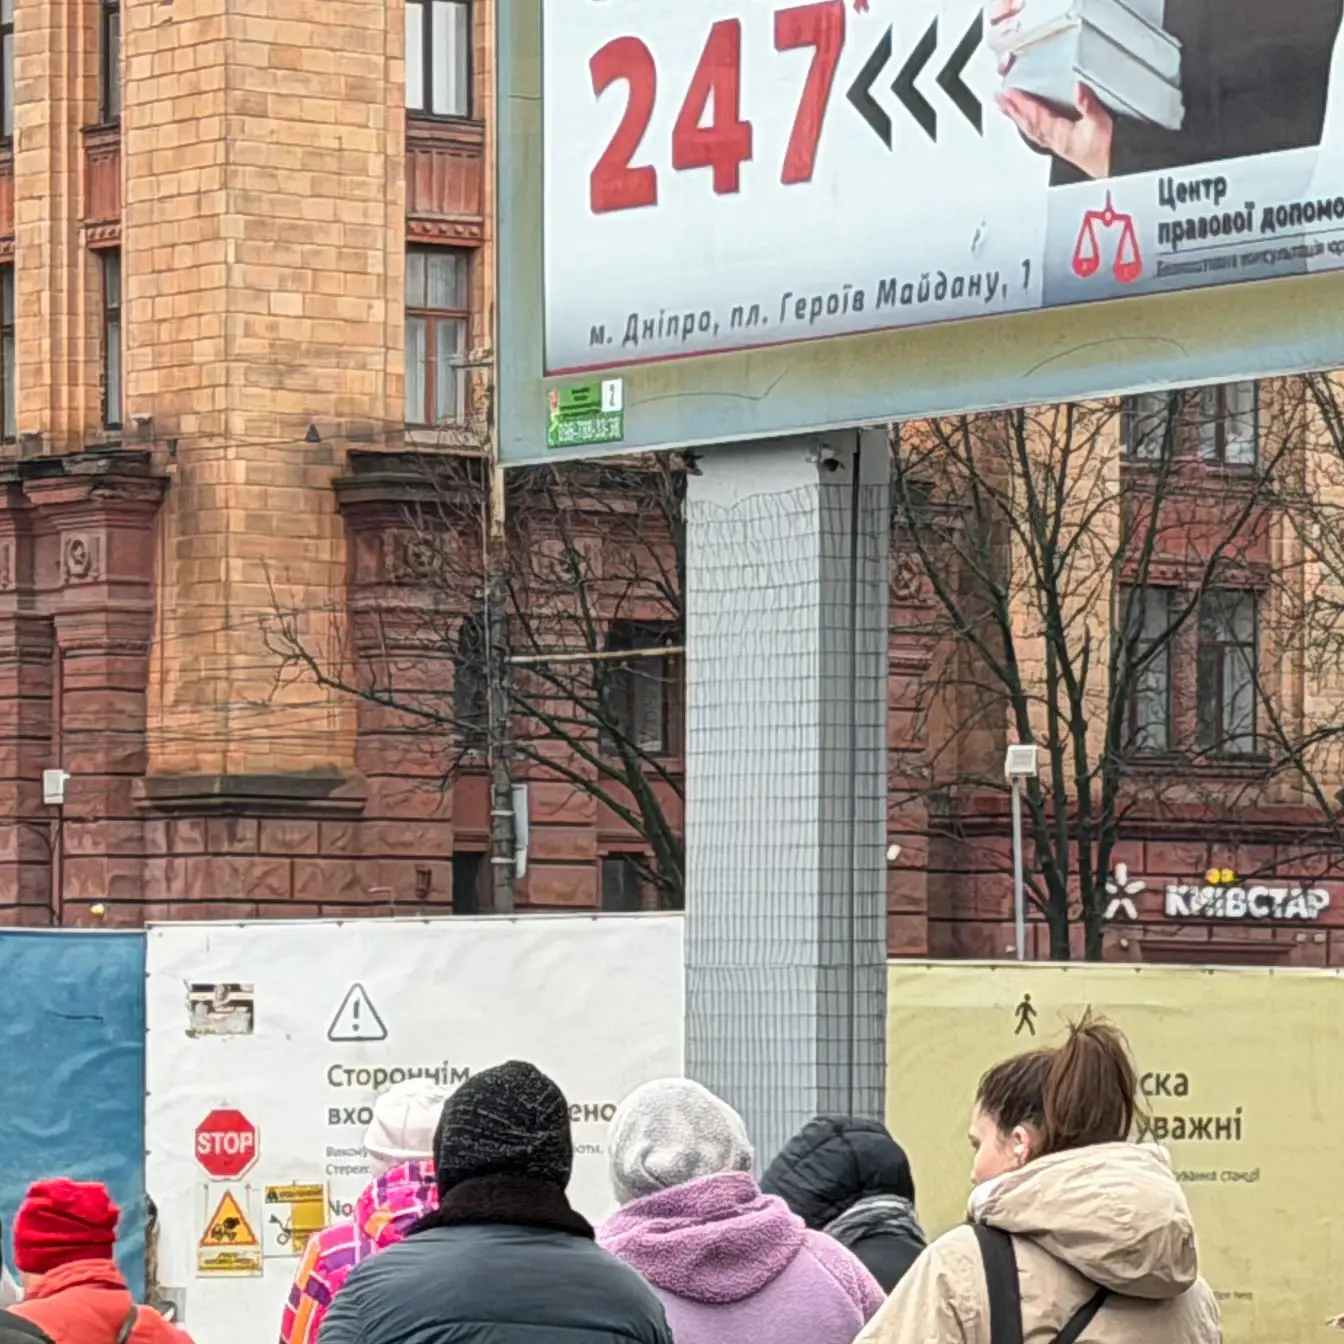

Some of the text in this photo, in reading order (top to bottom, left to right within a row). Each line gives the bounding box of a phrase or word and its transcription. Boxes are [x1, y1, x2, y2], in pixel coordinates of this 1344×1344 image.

[589, 0, 846, 213] 247
[1158, 176, 1227, 211] Центр
[1158, 201, 1255, 249] правової
[590, 259, 1031, 347] м. Дніпро, пл. Героїв Майдану, 1
[1165, 868, 1330, 919] КИЇВСТАР
[196, 1132, 254, 1155] STOP
